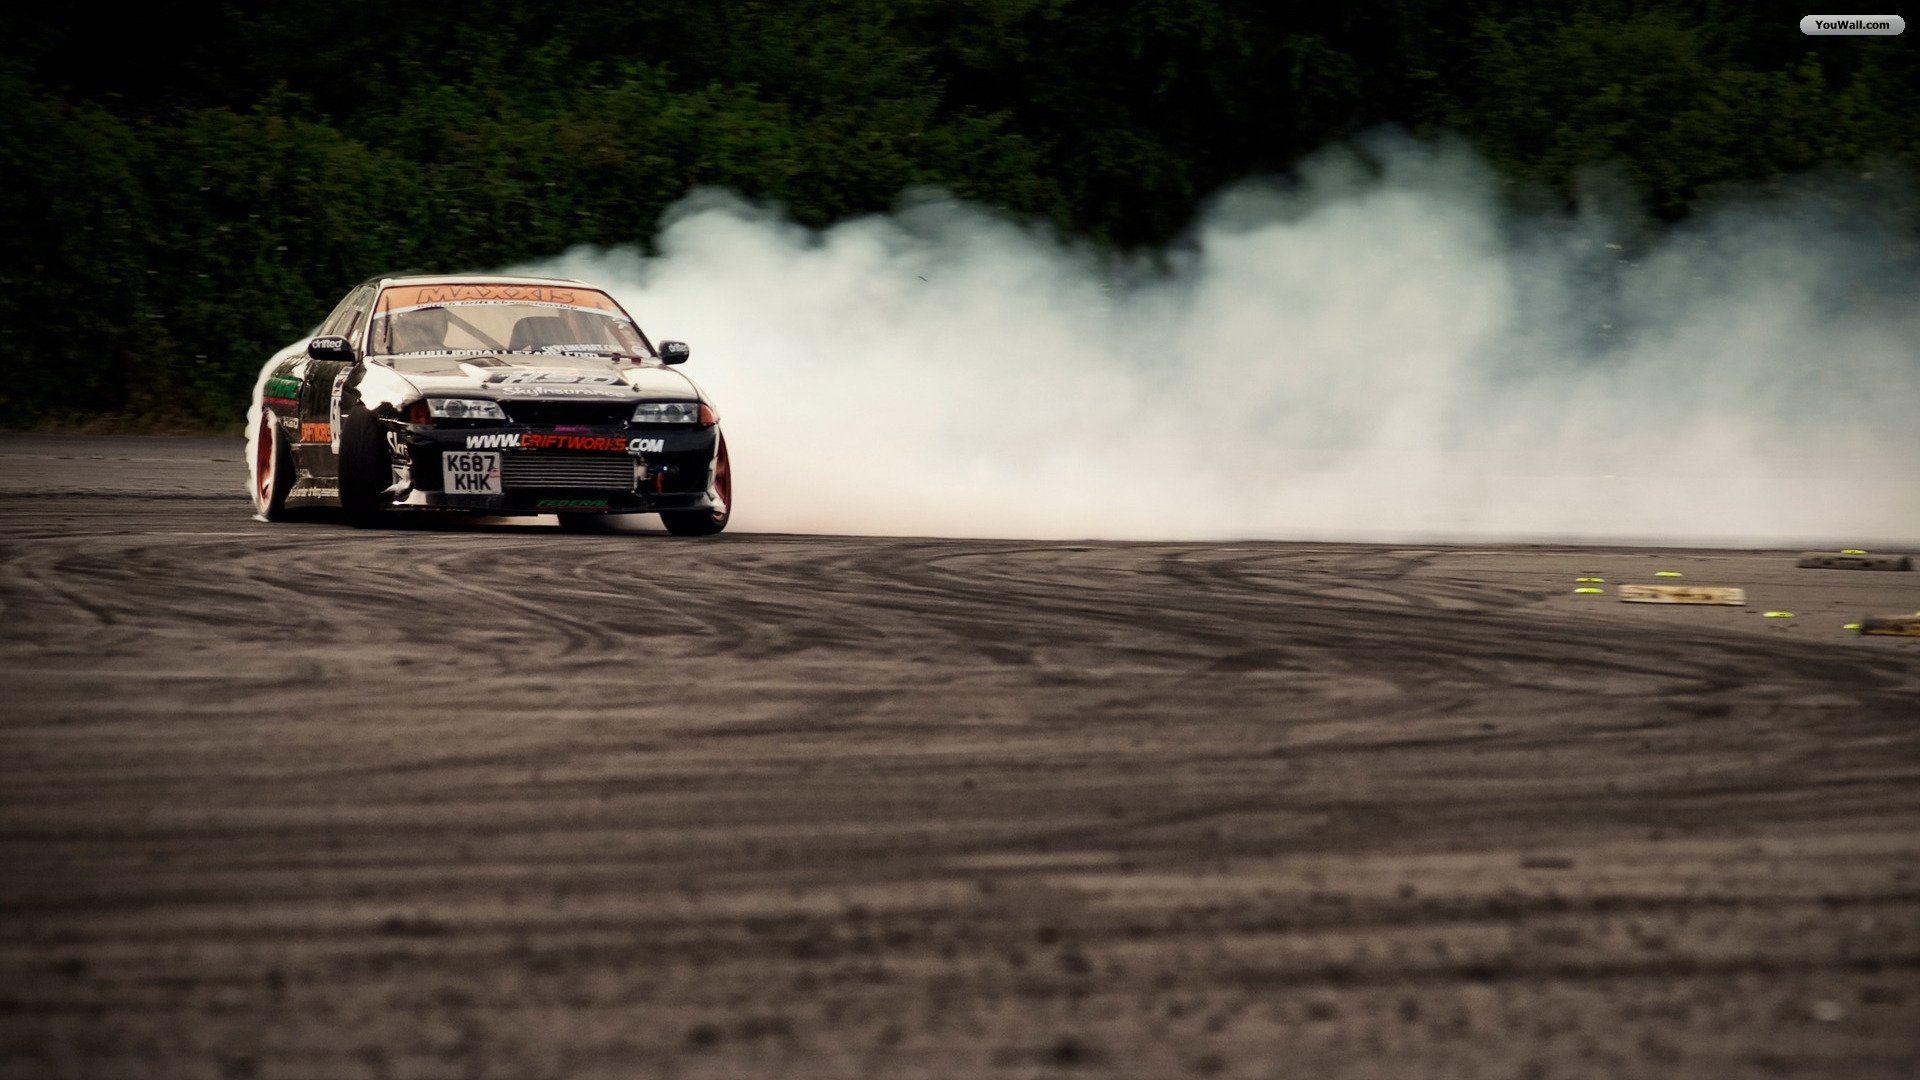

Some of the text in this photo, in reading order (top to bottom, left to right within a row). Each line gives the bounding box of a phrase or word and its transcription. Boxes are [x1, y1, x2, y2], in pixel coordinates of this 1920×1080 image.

[416, 285, 575, 305] MAXXIS
[312, 339, 343, 349] drifted
[466, 432, 665, 453] WWW.DRIFTWORKS.COM
[447, 454, 495, 473] K687
[454, 473, 491, 491] KHK
